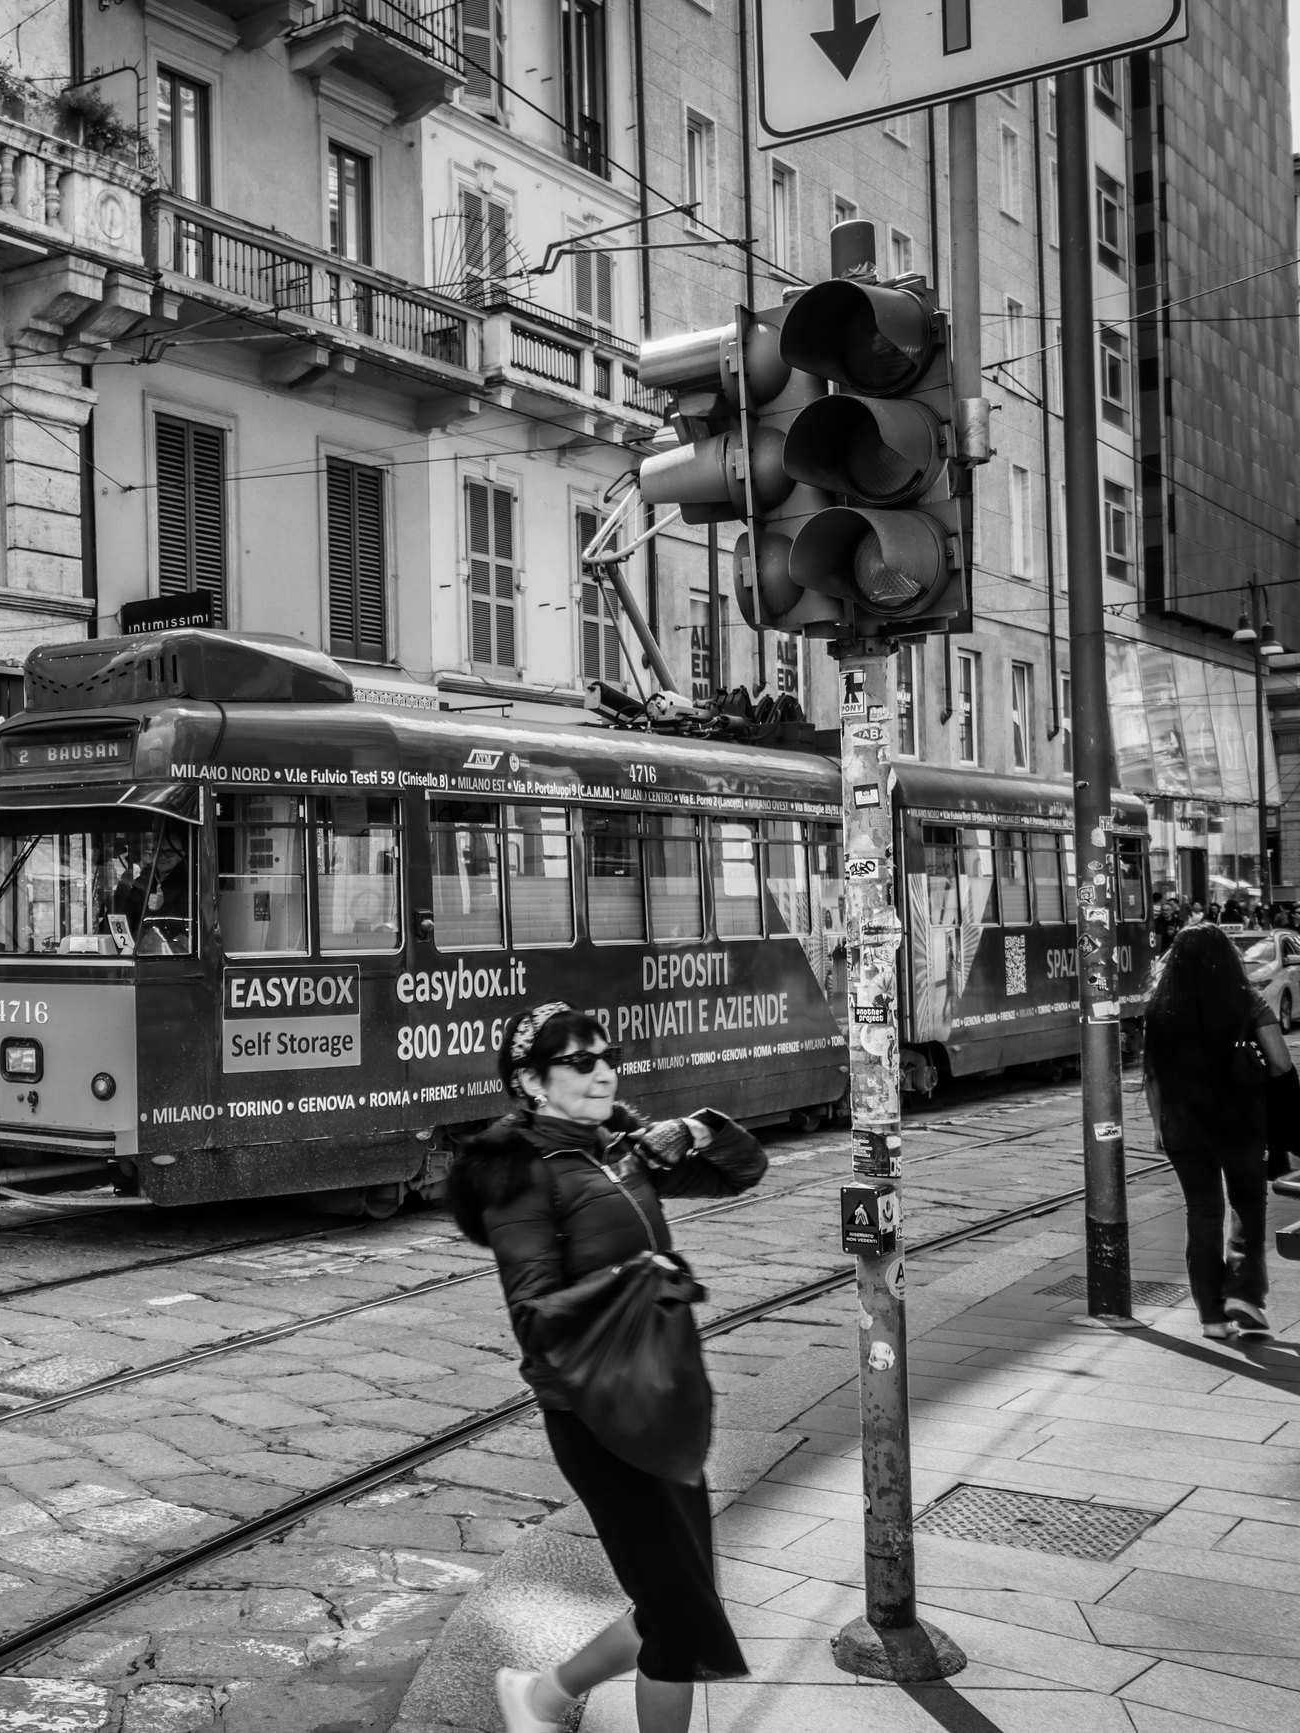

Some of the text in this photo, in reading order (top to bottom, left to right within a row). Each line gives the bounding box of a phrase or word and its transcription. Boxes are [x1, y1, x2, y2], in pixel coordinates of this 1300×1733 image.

[128, 613, 209, 634] intimissimi
[19, 743, 119, 764] 2 BAUSAN
[475, 754, 493, 765] ATM
[171, 764, 227, 780] MILANO
[231, 767, 270, 782] NORD
[284, 768, 307, 783] V.le
[311, 769, 348, 784] Fulvio
[351, 770, 377, 785] Testi
[381, 771, 395, 785] 59
[398, 770, 438, 788] (Cinisello
[458, 776, 490, 791] MILANO
[492, 778, 505, 792] EST
[513, 780, 526, 794] Via
[527, 781, 534, 794] P.
[534, 782, 571, 798] Portaluppi
[649, 791, 673, 804] CENTRO
[679, 793, 689, 805] Via
[772, 800, 789, 811] OVEST
[629, 764, 657, 784] 4716
[115, 922, 124, 935] 8
[119, 935, 128, 947] 2
[396, 958, 526, 1010] easybox.it
[642, 952, 728, 991] DEPOSITI
[230, 976, 354, 1008] EASYBOX
[617, 999, 692, 1042] PRIVATI
[699, 1000, 709, 1032] E
[714, 992, 788, 1031] AZIENDE
[231, 1030, 354, 1058] Self Storage
[397, 1017, 512, 1061] 800 202 6
[622, 1059, 651, 1076] FIRENZE
[657, 1055, 684, 1071] MILANO
[690, 1051, 716, 1066] TORINO
[721, 1048, 748, 1062] GENOVA
[753, 1045, 772, 1058] ROMA
[777, 1041, 800, 1055] FIRENZE
[804, 1038, 827, 1051] MILANO
[153, 1078, 503, 1125] MILANO TORINO GENOVA ROMA FIRENZE MILANO
